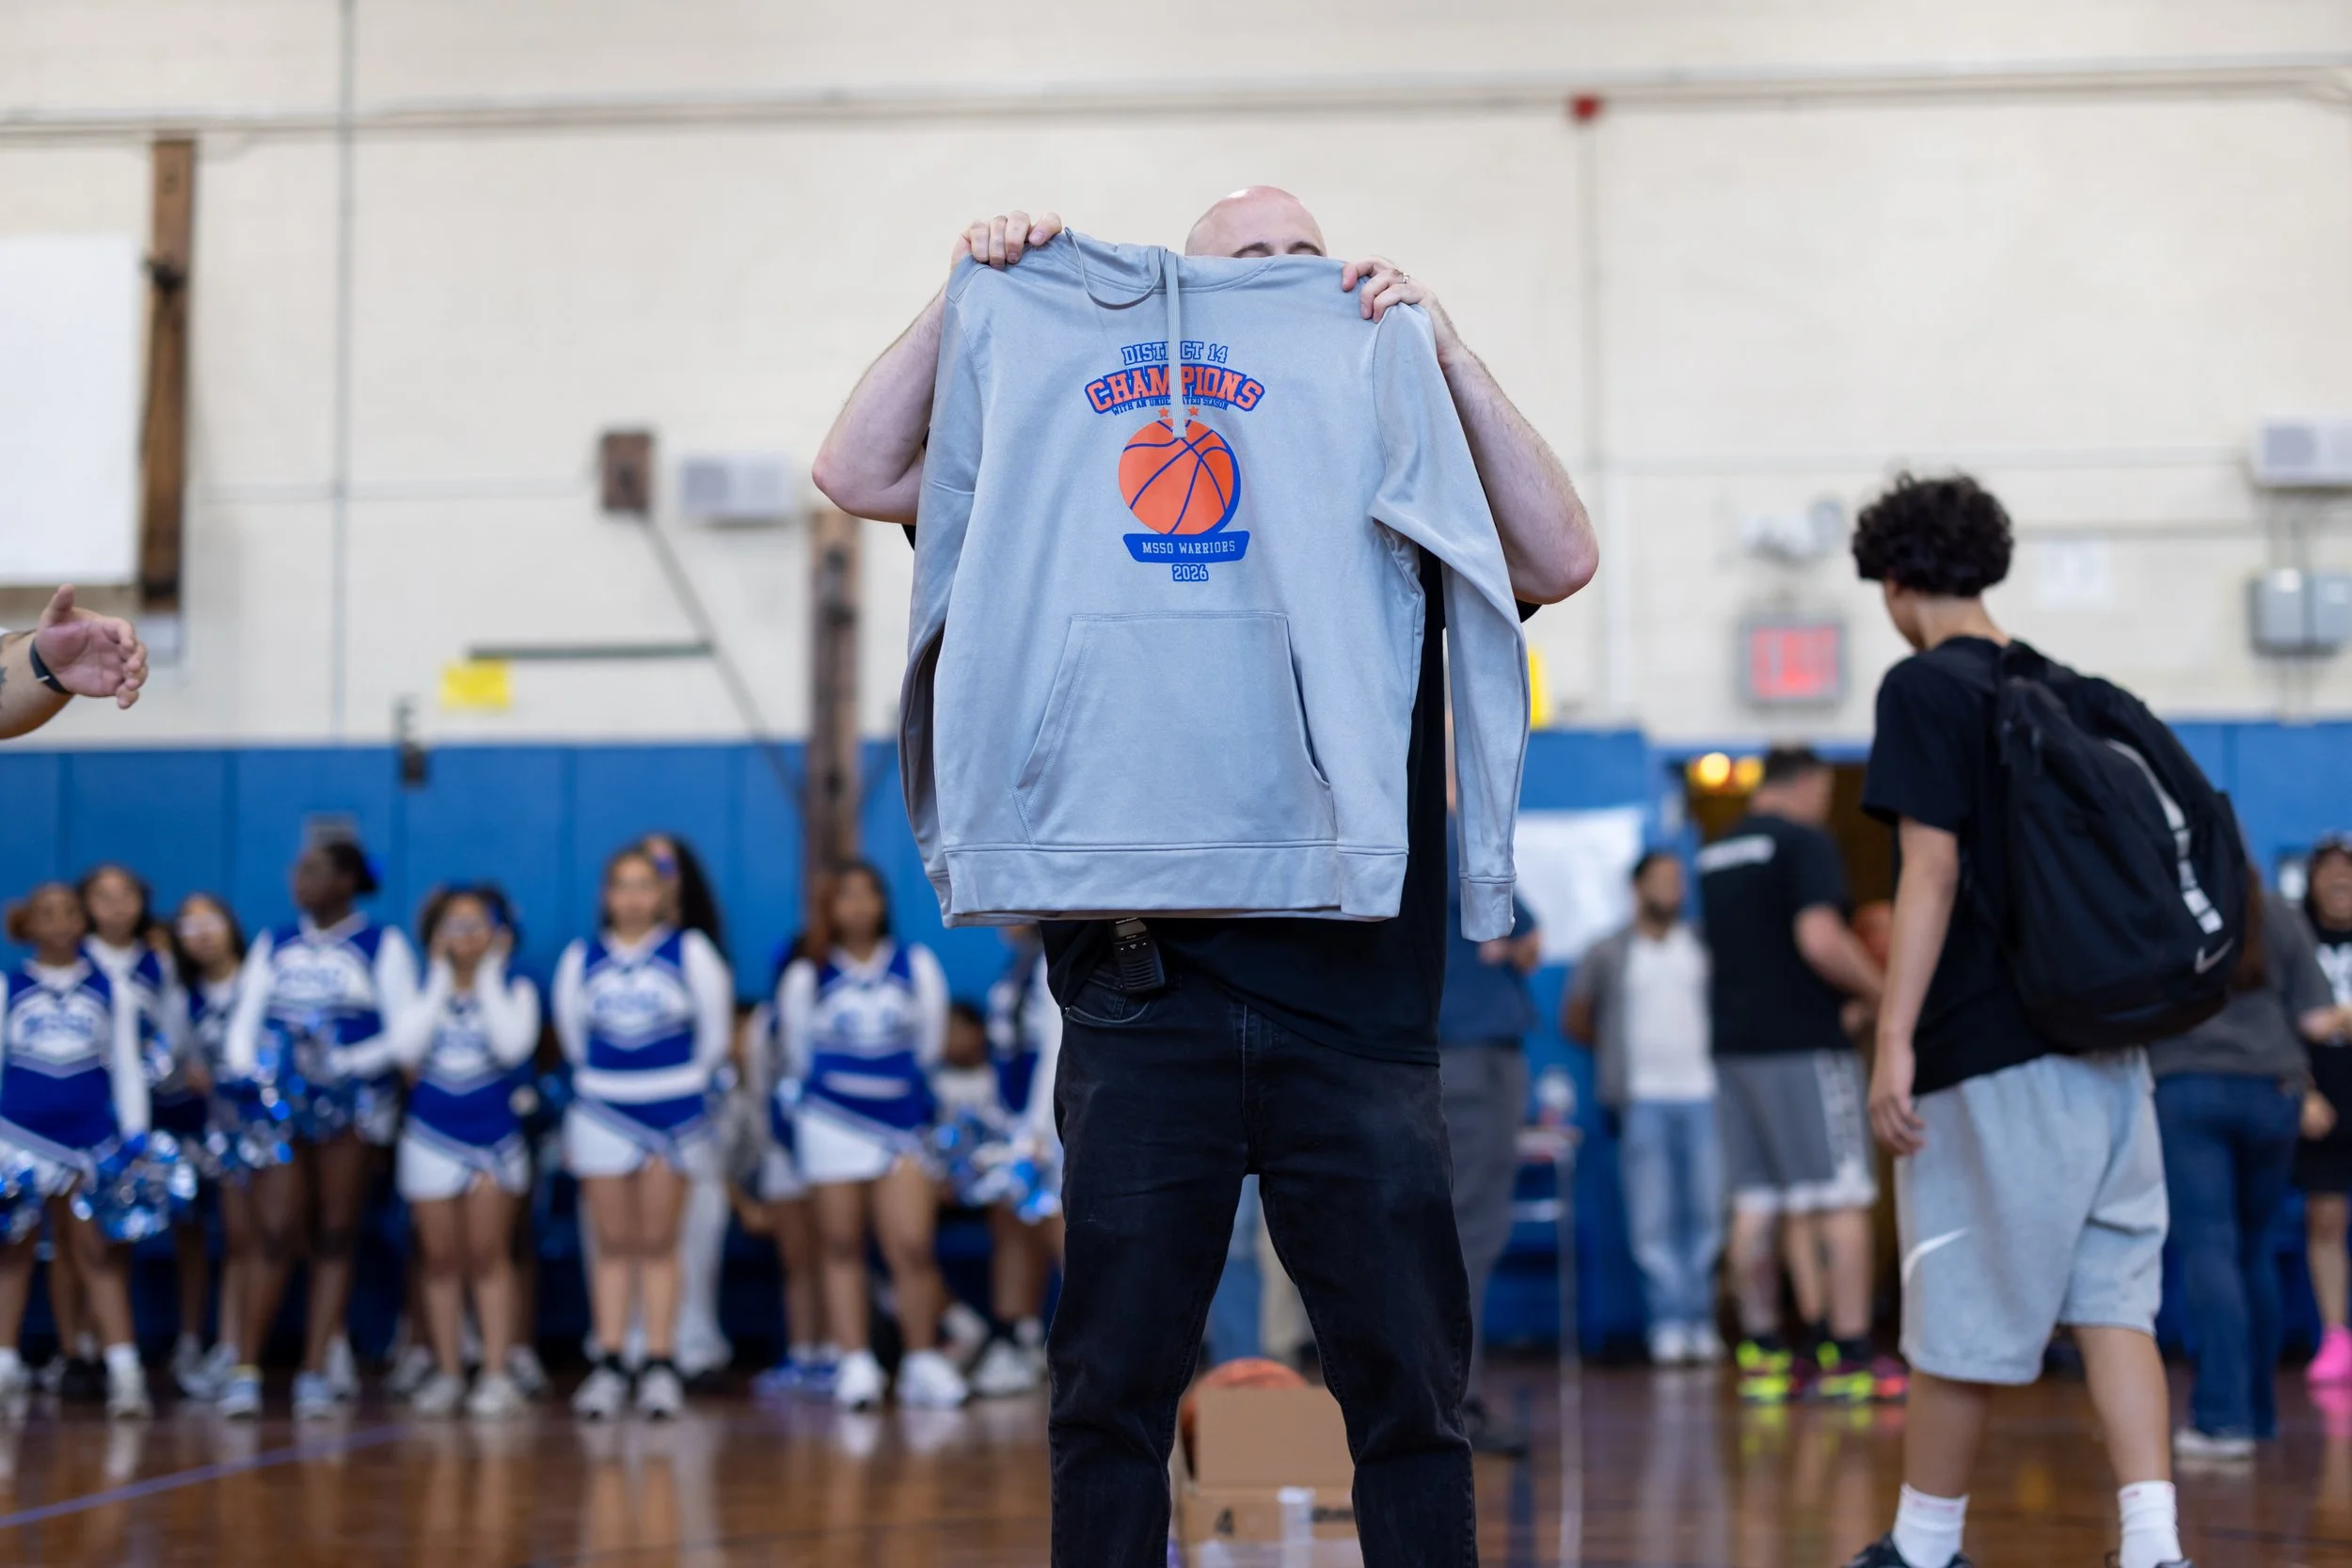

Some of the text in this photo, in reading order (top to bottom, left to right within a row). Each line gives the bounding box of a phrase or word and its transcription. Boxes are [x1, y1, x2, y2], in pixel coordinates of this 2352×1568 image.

[1121, 341, 1228, 366] DISTCT 14
[1112, 401, 1134, 416] WITH
[1136, 399, 1147, 408] AN
[1203, 397, 1229, 410] SEASON
[1179, 540, 1235, 554] WARRIORS
[1172, 564, 1209, 582] 2026
